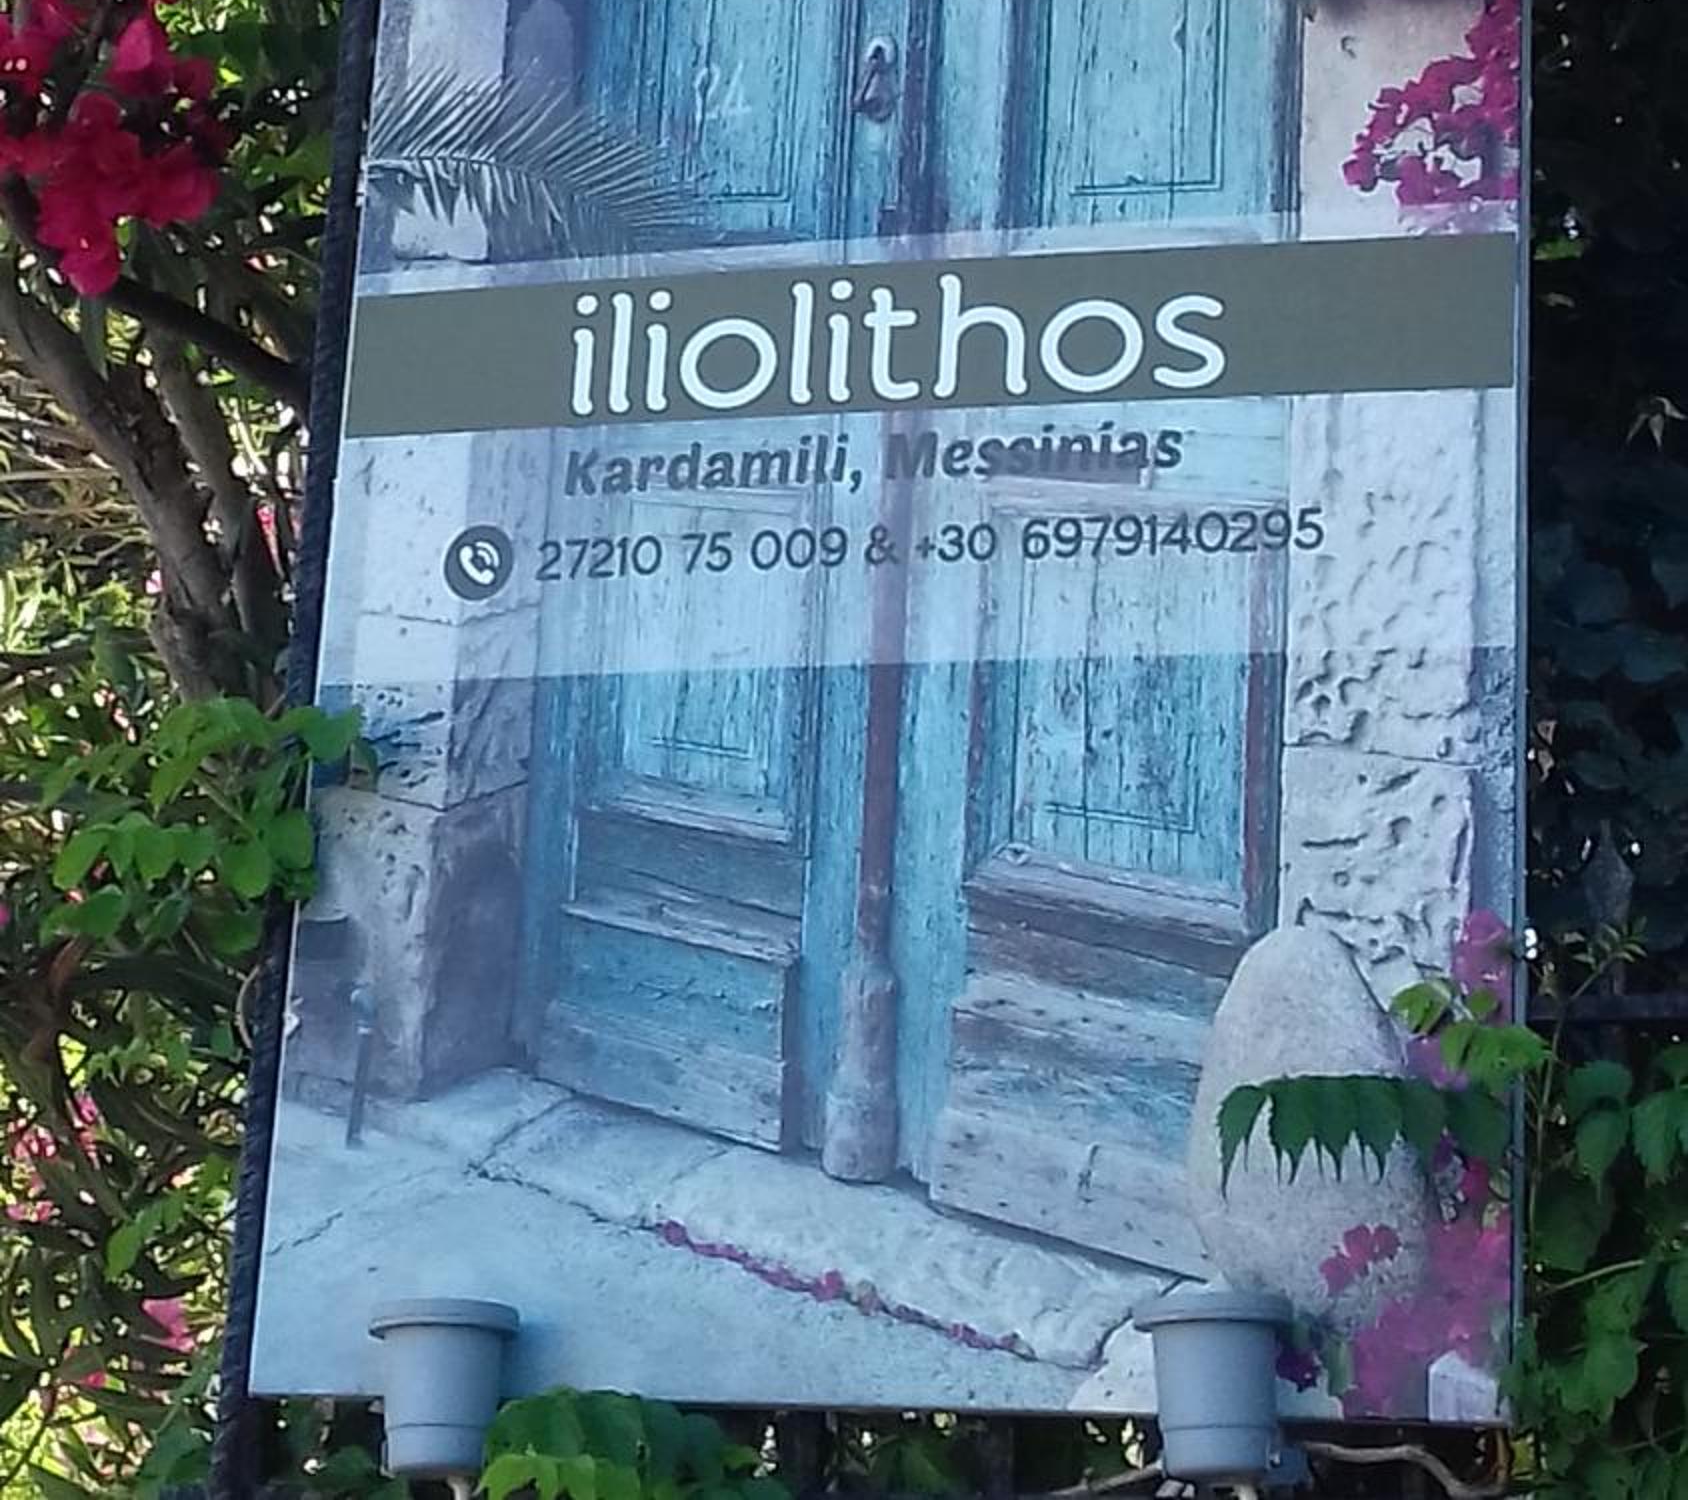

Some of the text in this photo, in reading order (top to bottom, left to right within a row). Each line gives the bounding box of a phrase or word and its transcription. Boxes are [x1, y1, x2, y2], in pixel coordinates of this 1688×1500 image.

[572, 273, 1227, 415] iliolithos
[564, 421, 1183, 497] Kardamili, Messinias
[535, 507, 1324, 581] 27210 75 009 & +30 6979140295
